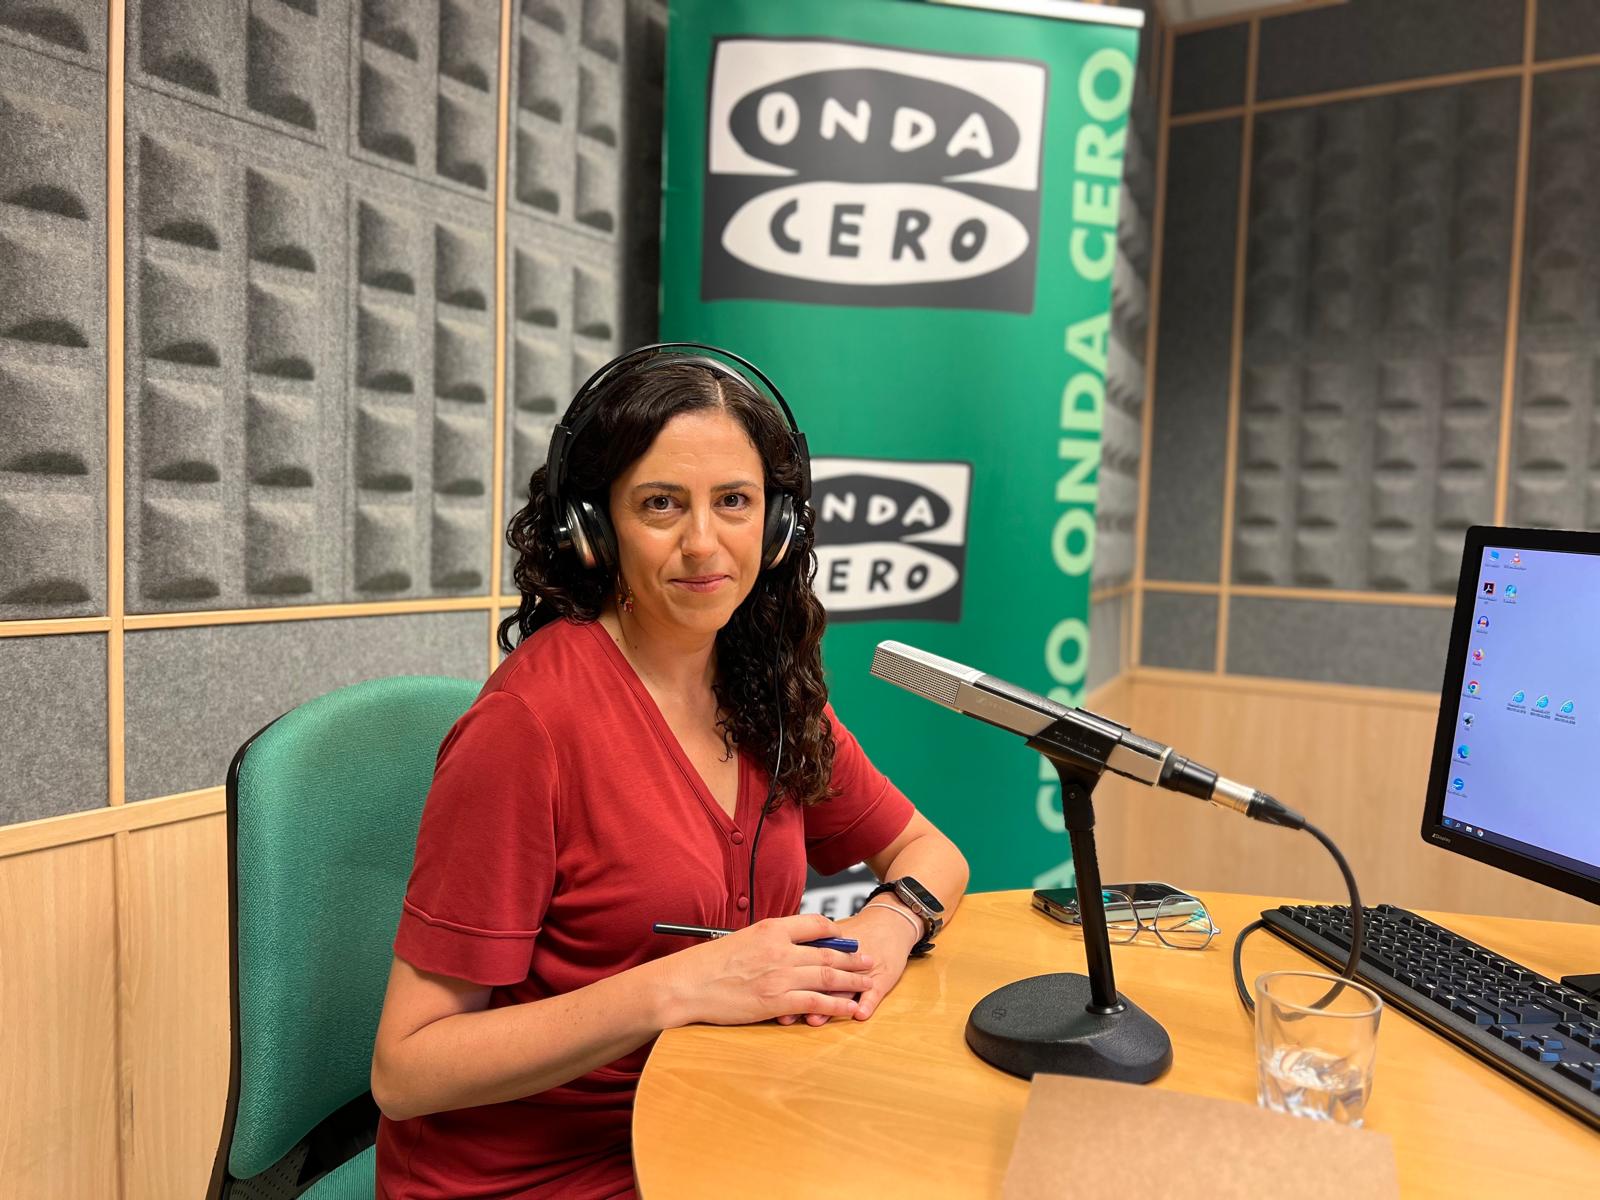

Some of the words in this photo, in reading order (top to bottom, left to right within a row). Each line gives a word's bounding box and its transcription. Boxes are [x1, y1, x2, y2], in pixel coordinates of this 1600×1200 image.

[757, 92, 993, 159] ONDA
[1069, 48, 1136, 282] CERO
[769, 198, 988, 264] CERO
[1051, 312, 1112, 577] ONDA
[821, 491, 935, 528] NDA
[827, 557, 930, 593] ERO
